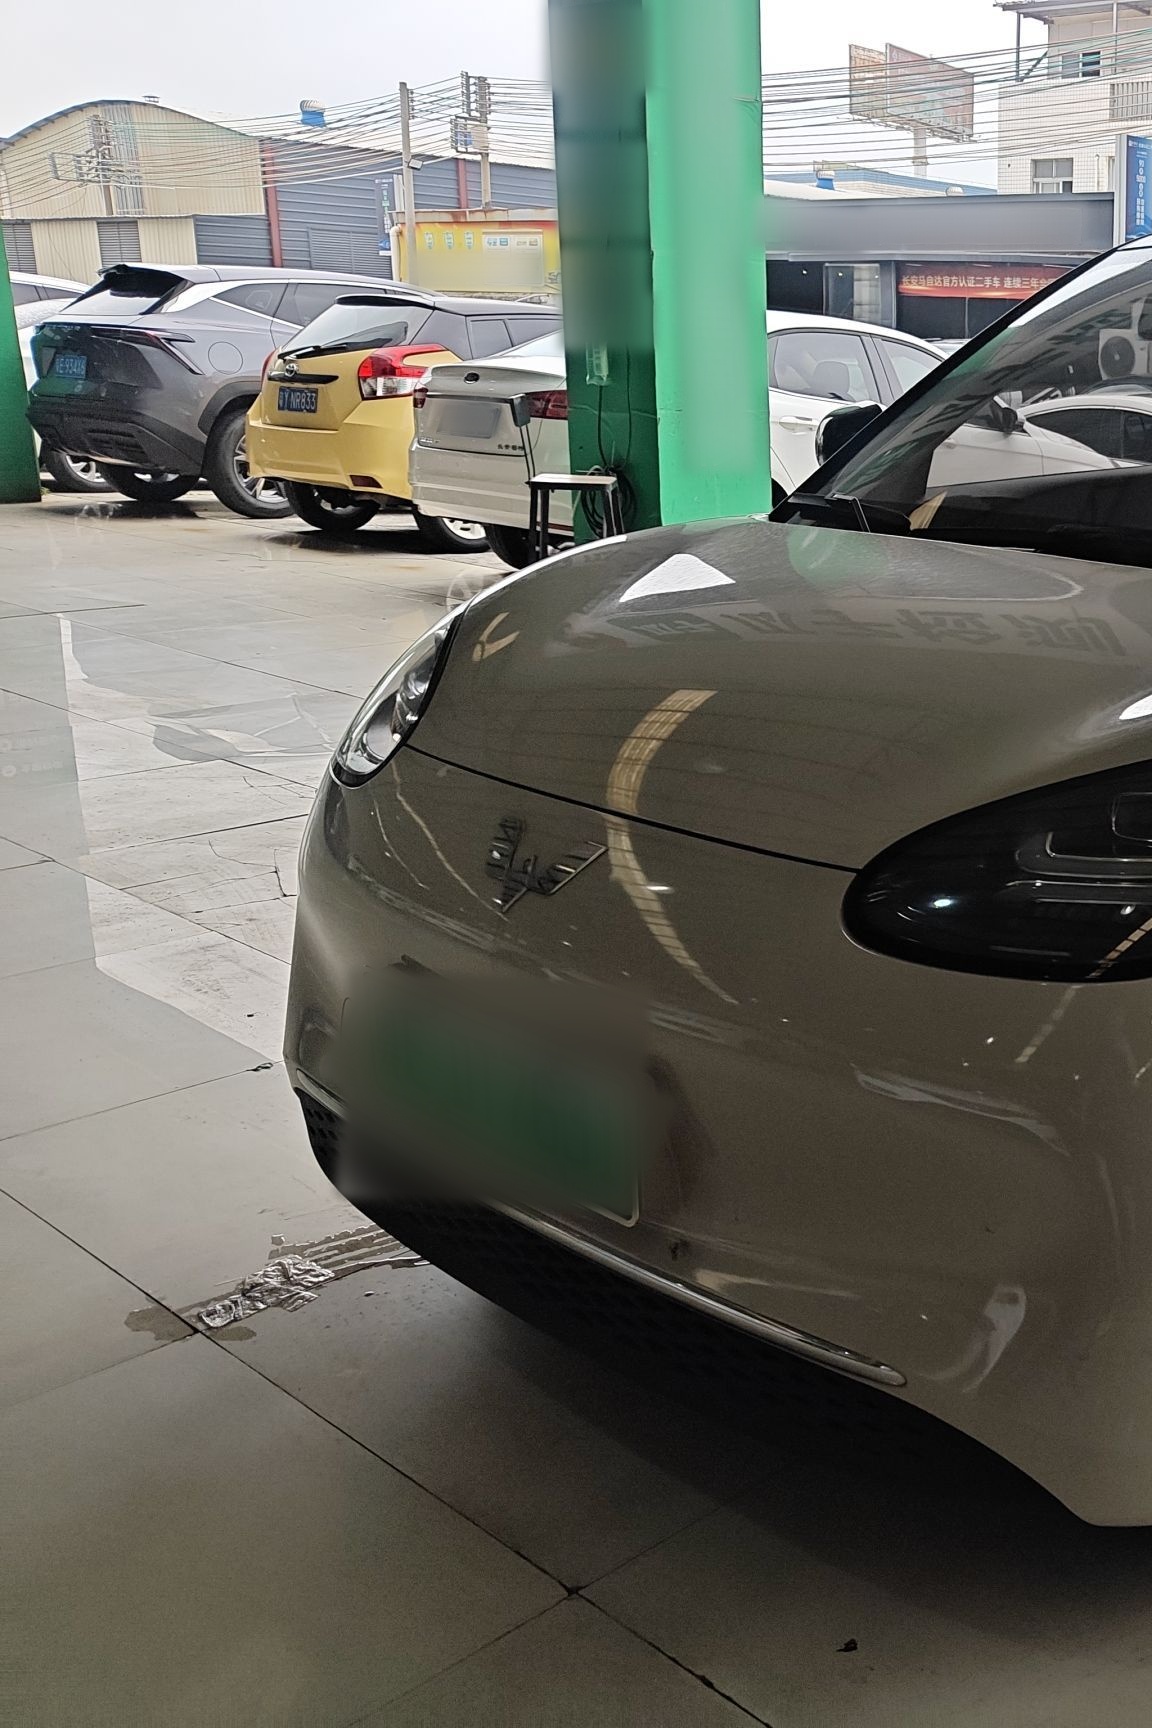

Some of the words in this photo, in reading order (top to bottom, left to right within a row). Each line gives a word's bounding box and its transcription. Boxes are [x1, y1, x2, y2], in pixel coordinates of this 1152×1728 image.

[902, 274, 1001, 290] 长安马自达官方认证二手车
